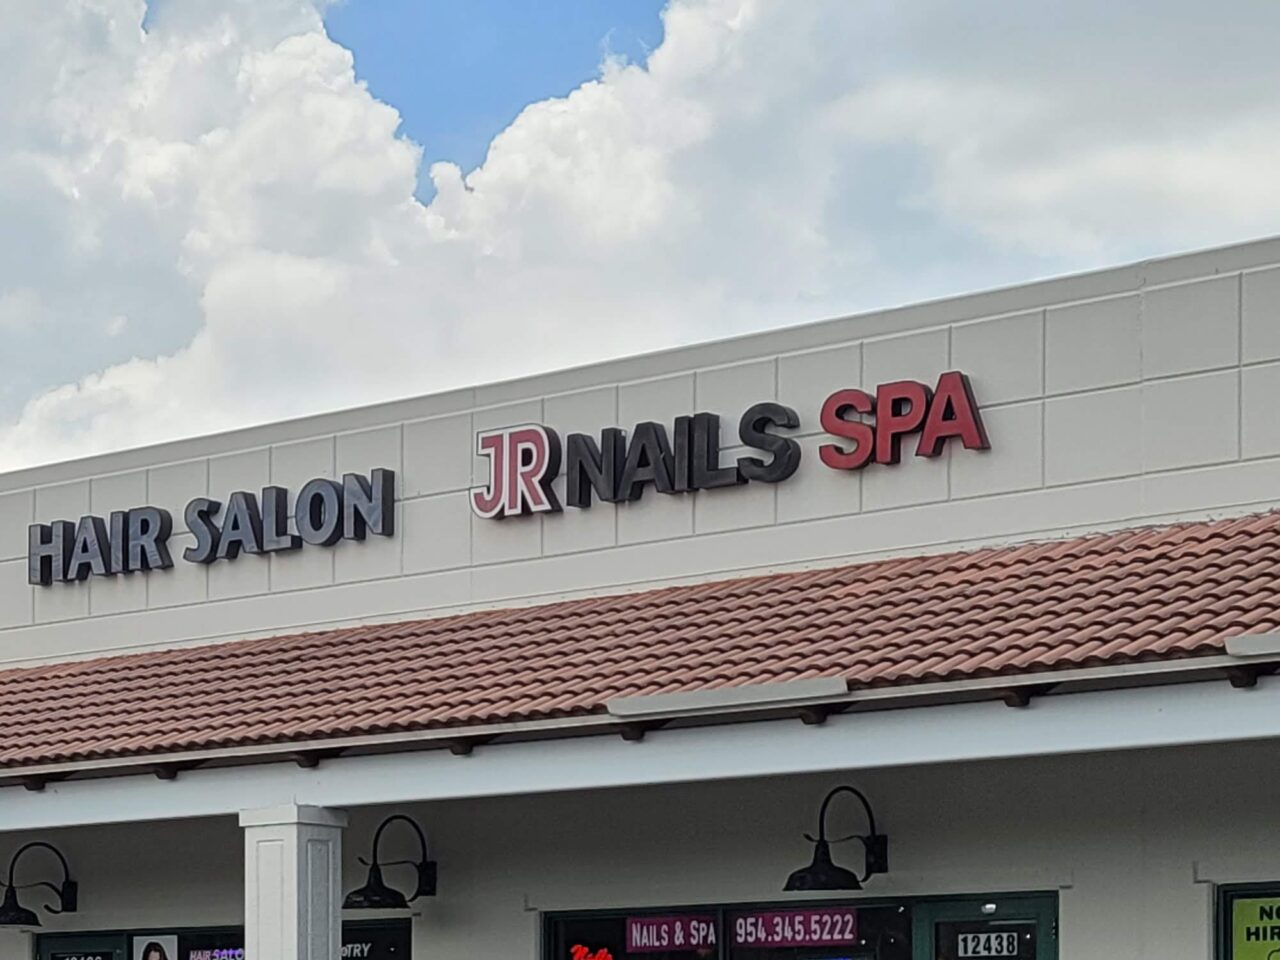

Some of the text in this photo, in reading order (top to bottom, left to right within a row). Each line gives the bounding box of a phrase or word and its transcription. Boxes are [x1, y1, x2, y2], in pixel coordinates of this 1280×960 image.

[470, 371, 992, 520] JR NAILS SPA
[28, 468, 395, 585] HAIR SALON
[674, 920, 685, 946] &
[735, 913, 854, 943] 954.345.5222
[1246, 926, 1280, 941] HIR
[961, 934, 1016, 955] 12438
